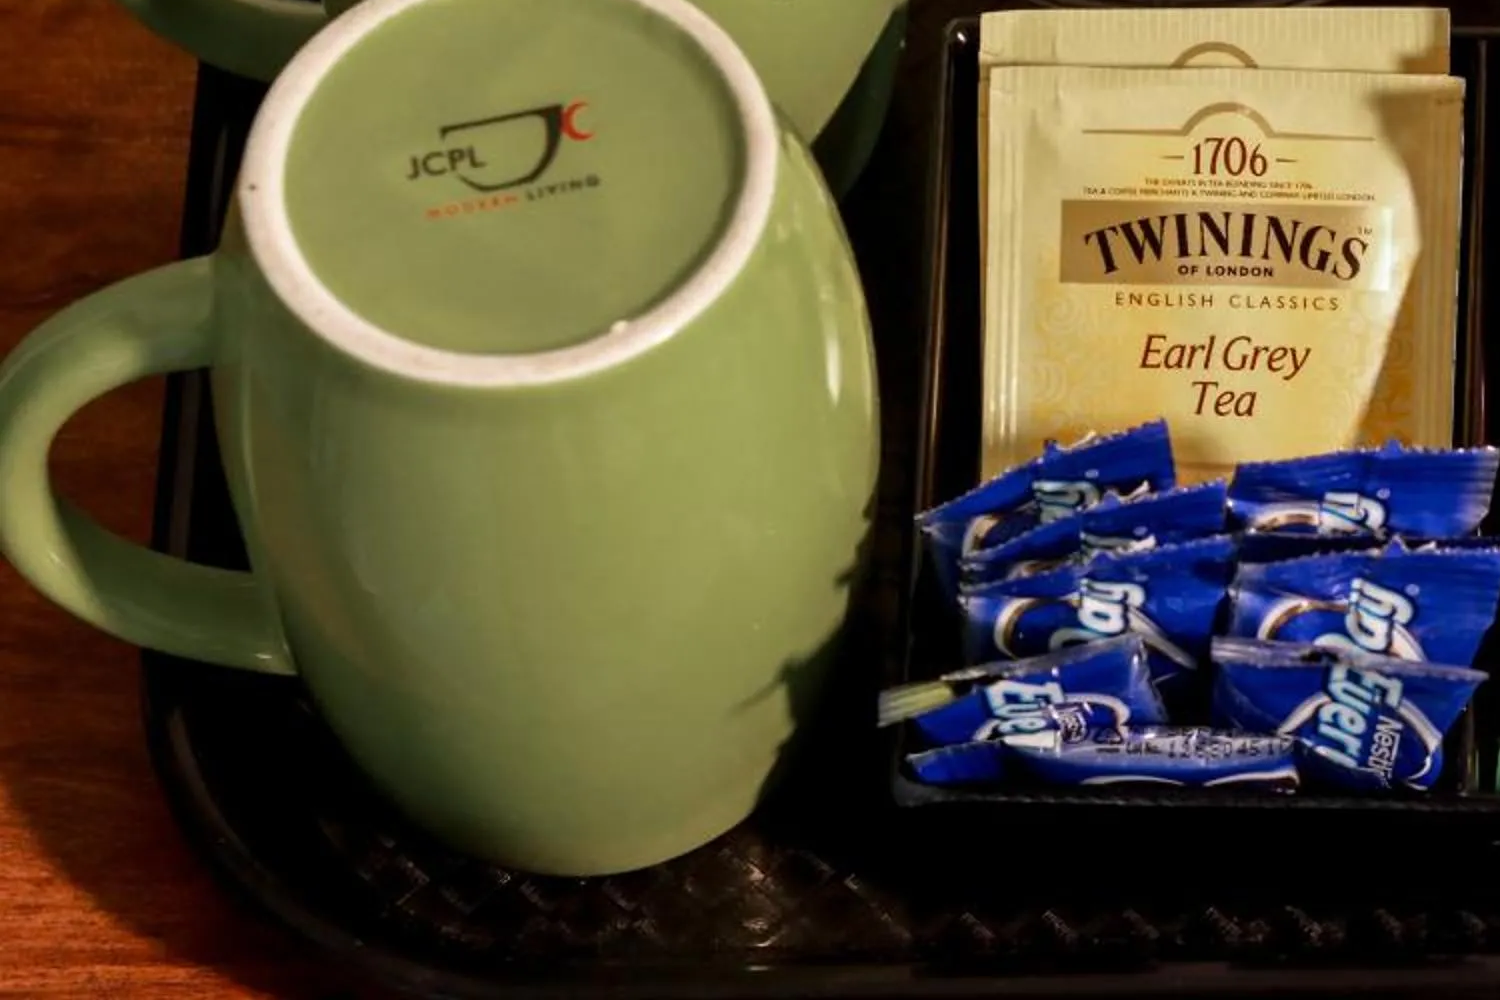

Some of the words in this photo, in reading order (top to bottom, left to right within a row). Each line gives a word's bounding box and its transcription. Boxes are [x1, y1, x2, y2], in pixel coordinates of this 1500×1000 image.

[406, 145, 487, 181] JCPL
[1192, 136, 1269, 177] 1706
[1083, 210, 1370, 282] TWININGS
[1177, 264, 1200, 277] OF
[1205, 264, 1275, 278] LONDON
[1114, 291, 1215, 309] ENGLISH
[1228, 294, 1341, 312] CLASSICS
[1139, 333, 1217, 370] Earl
[1222, 335, 1312, 381] Grey
[1191, 380, 1258, 418] Tea
